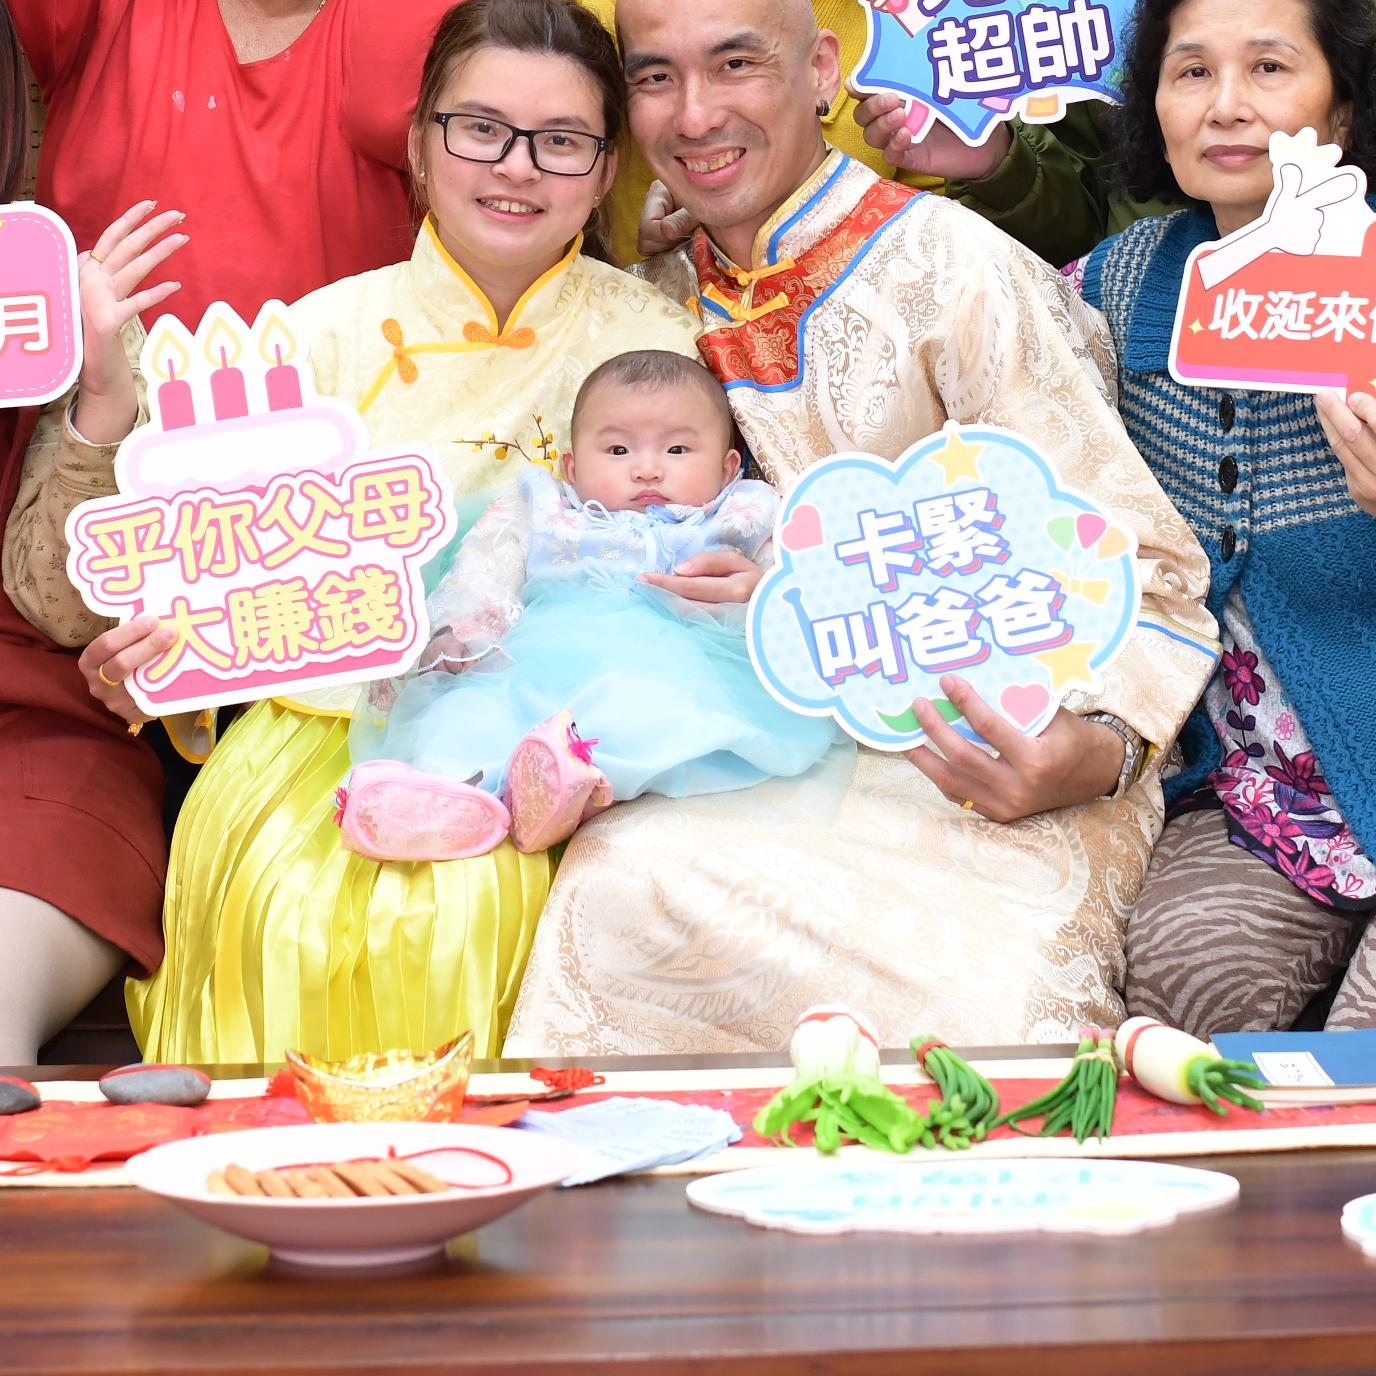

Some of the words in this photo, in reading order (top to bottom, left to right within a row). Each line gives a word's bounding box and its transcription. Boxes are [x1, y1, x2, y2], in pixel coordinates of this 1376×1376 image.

[932, 0, 1111, 99] 超帥
[89, 467, 435, 592] 乎你父母
[837, 489, 1004, 589] 卡緊
[146, 568, 406, 680] 大賺錢
[812, 570, 1070, 680] 叫爸爸
